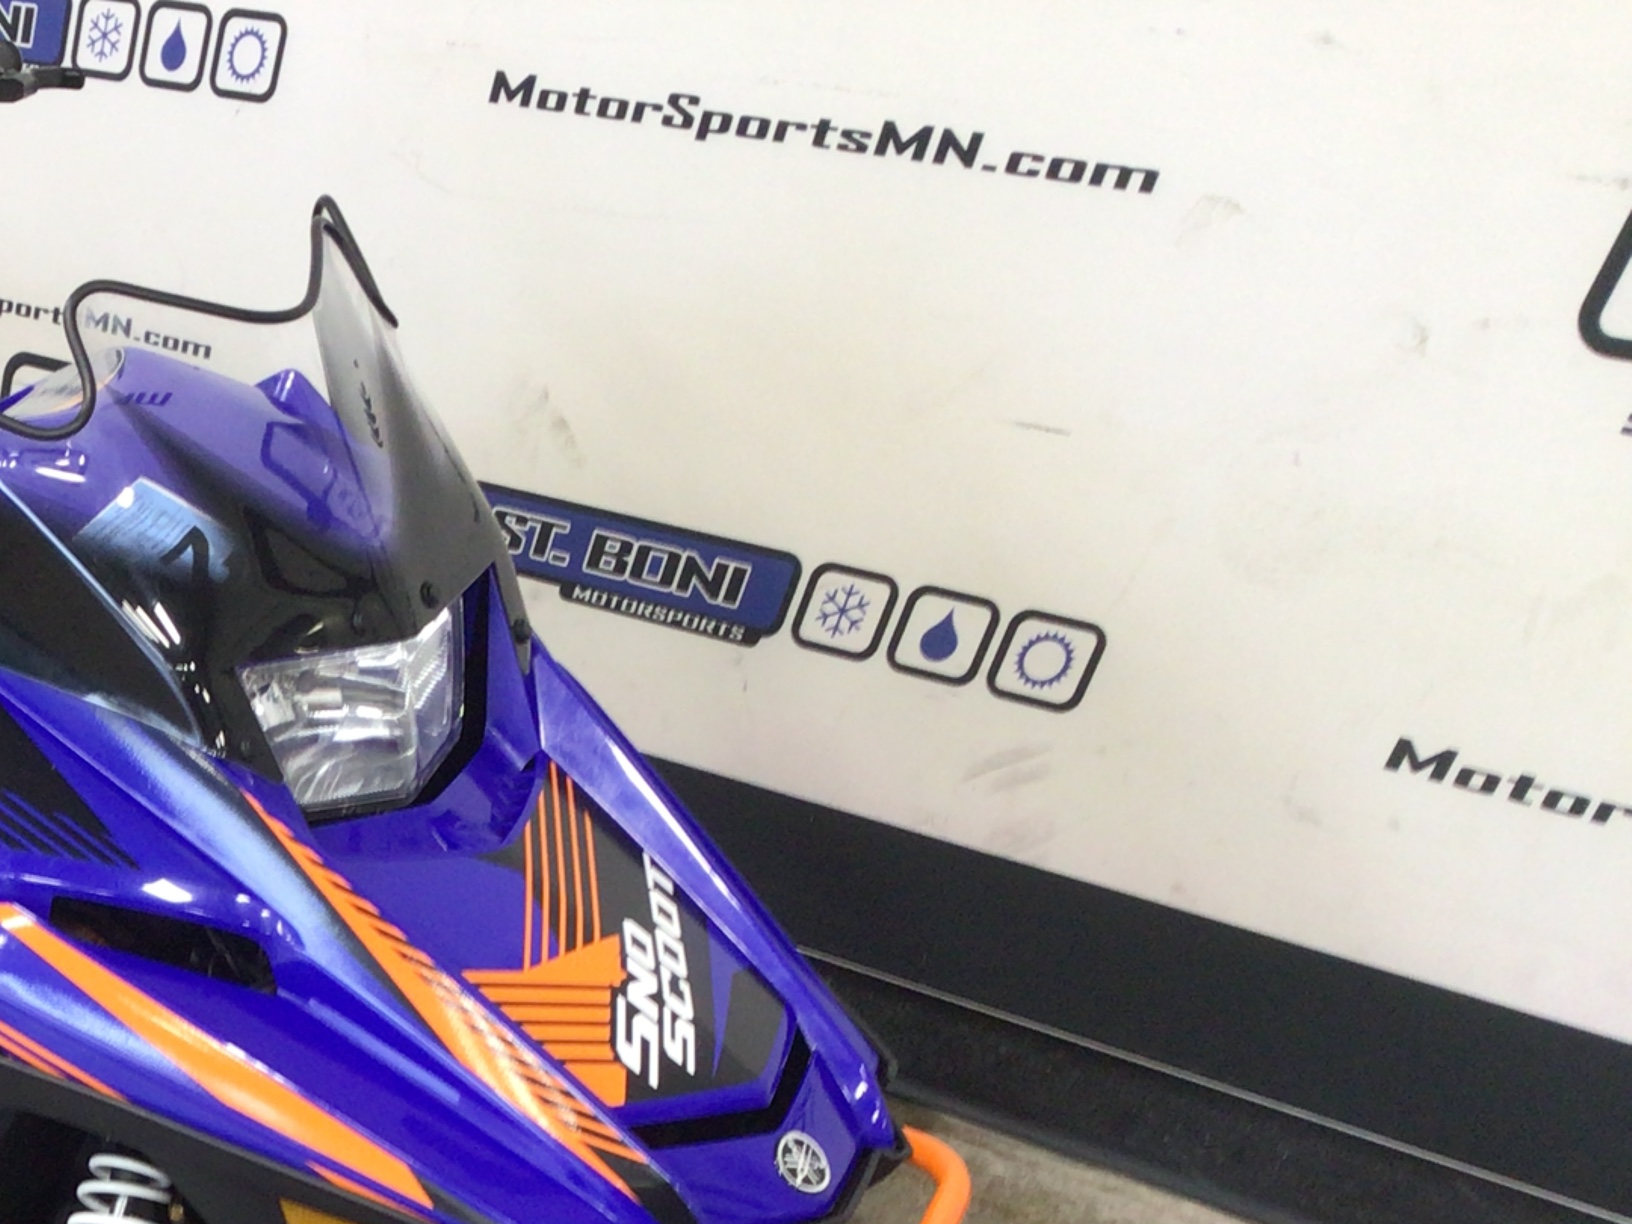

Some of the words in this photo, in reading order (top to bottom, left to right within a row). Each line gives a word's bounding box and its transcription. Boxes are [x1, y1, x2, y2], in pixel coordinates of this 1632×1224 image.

[488, 70, 1159, 194] MotorSportsMN.com
[493, 505, 570, 566] ST.
[582, 528, 751, 609] BONI
[572, 584, 746, 641] MOTORSPORTS
[616, 917, 659, 1090] SNO
[642, 851, 696, 1077] SCOOT
